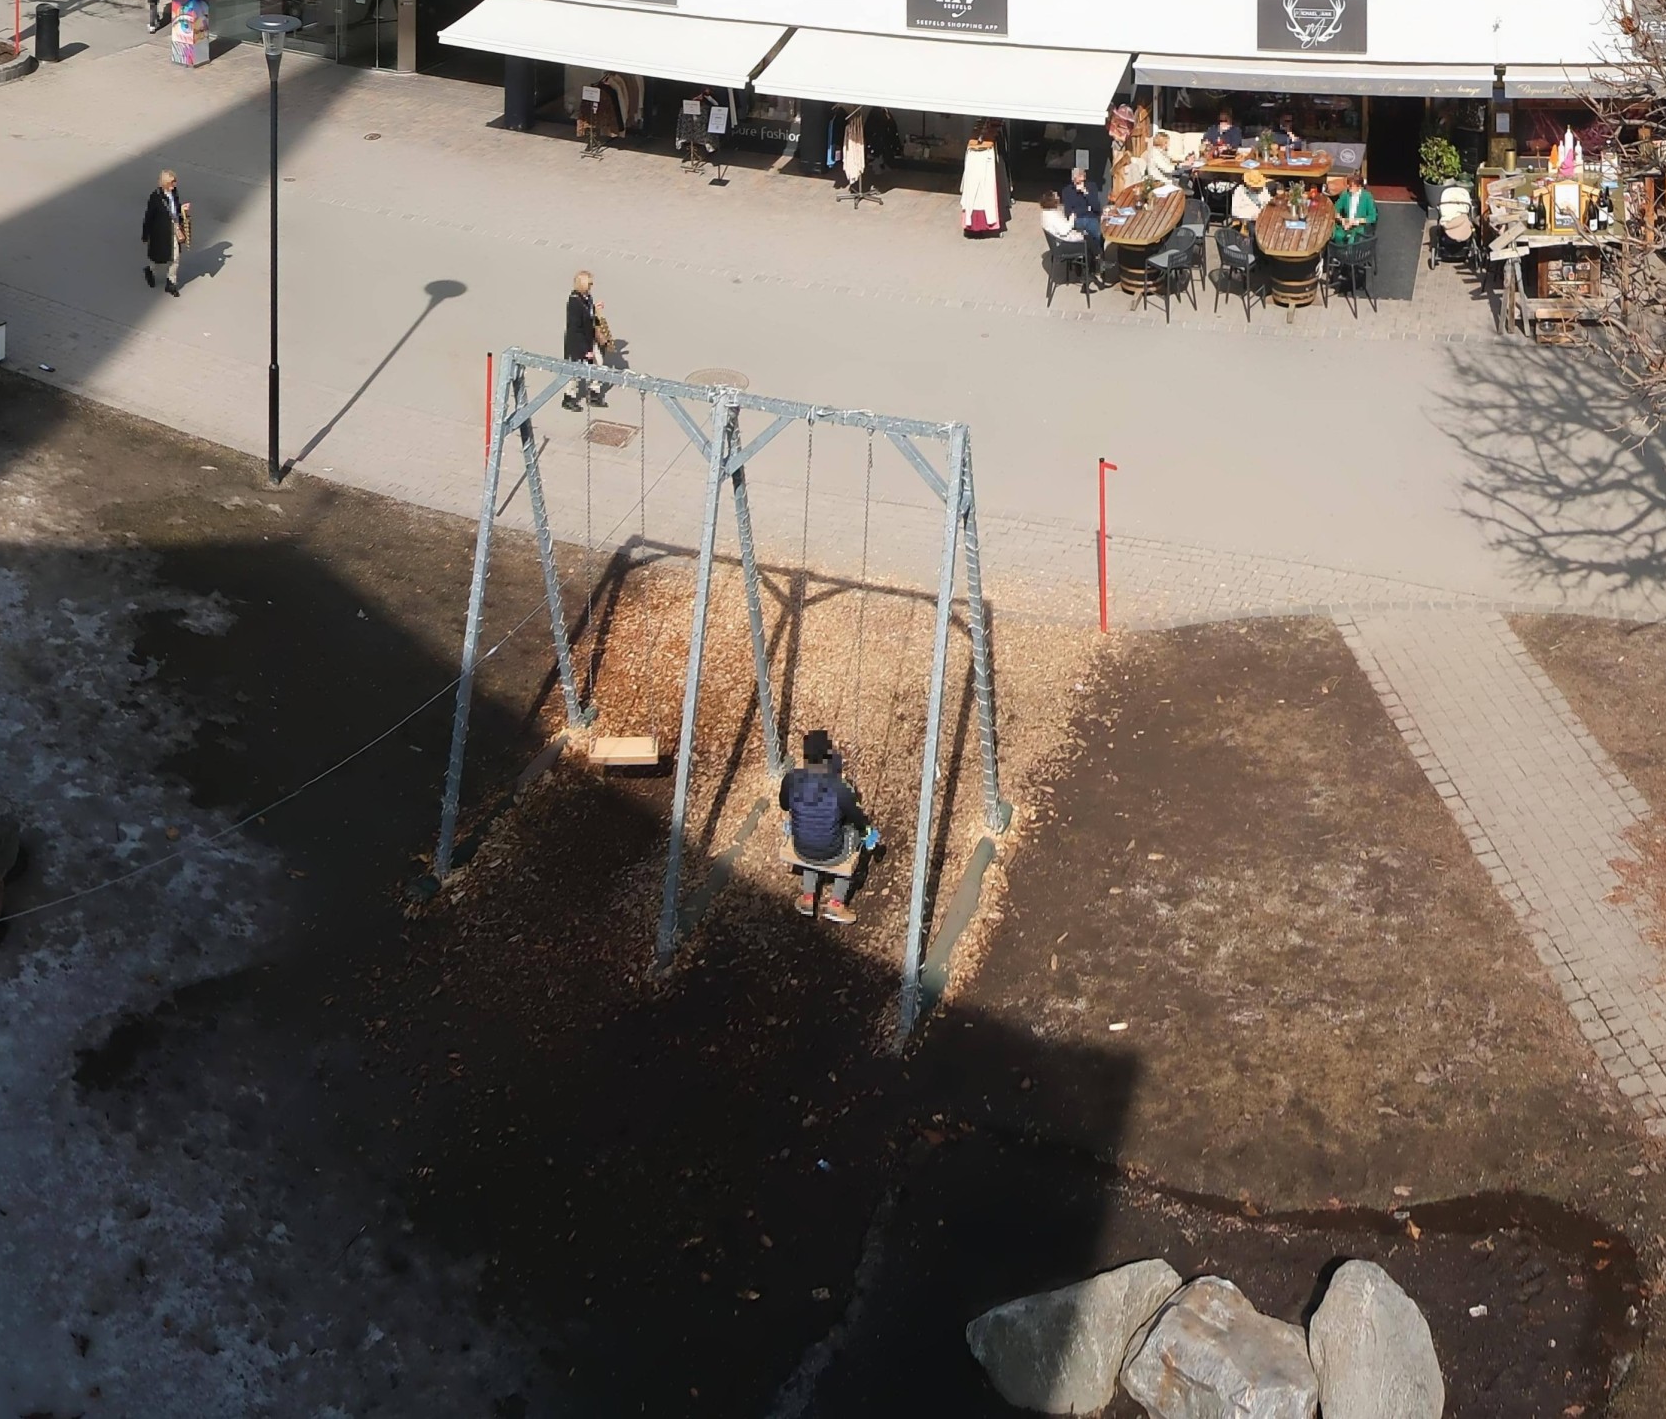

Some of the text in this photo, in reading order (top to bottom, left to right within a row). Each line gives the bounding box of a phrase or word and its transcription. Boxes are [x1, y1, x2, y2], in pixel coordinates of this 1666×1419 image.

[943, 3, 972, 11] SEEFELD
[916, 19, 945, 27] SEEFELD
[947, 21, 983, 30] SHOPPING
